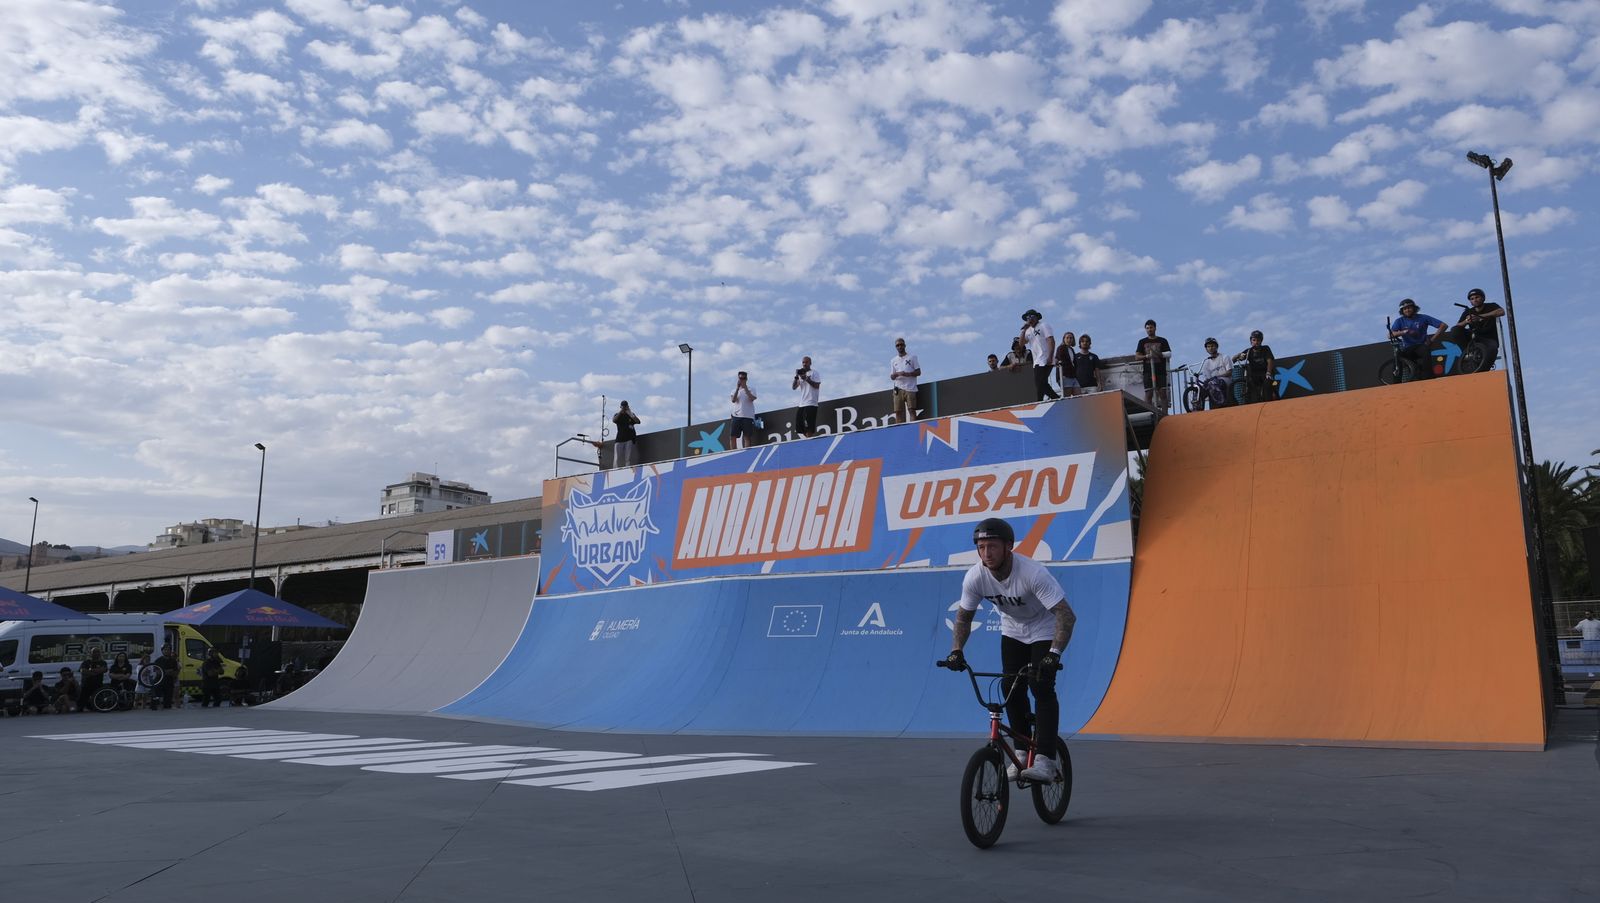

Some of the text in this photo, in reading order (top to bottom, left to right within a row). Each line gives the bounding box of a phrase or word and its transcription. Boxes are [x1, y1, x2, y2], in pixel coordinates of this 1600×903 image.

[900, 463, 1079, 520] URBAN
[561, 502, 659, 542] Andalucía
[677, 459, 870, 560] ANDALUCÍA
[434, 543, 446, 560] 59
[577, 540, 640, 565] URBAN
[870, 628, 903, 636] Andalucía
